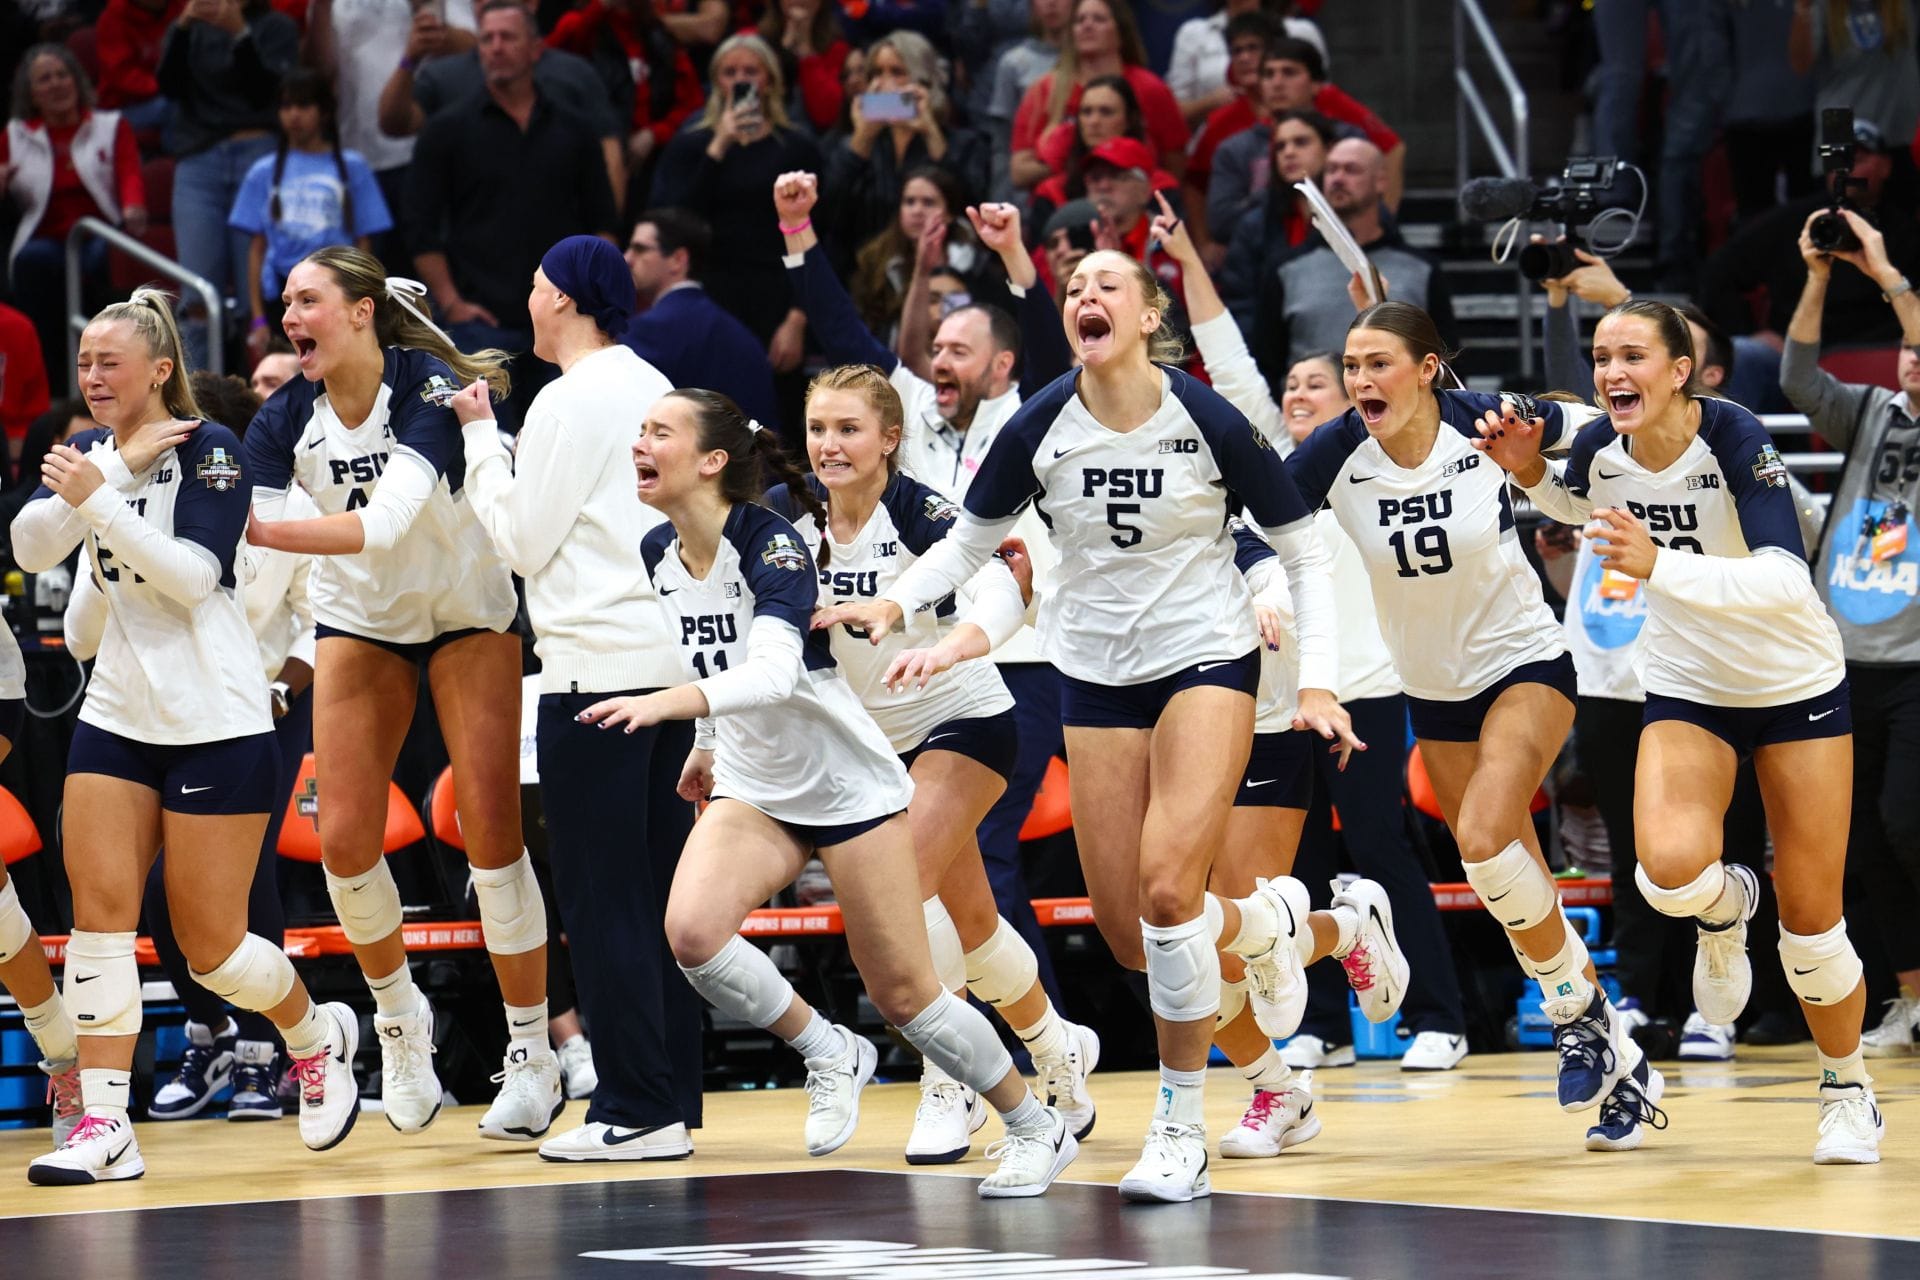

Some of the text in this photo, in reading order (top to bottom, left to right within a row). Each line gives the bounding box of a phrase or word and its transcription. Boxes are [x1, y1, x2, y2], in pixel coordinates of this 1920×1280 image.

[329, 452, 389, 485] PSU
[1083, 468, 1164, 498] PSU
[1378, 490, 1452, 526] PSU
[1626, 500, 1698, 532] PSU
[1106, 503, 1143, 548] 5
[1389, 525, 1453, 577] 19
[1829, 553, 1920, 597] NCAA
[680, 613, 738, 646] PSU
[429, 930, 451, 944] WIN
[453, 929, 479, 943] HERE
[803, 916, 829, 931] HERE
